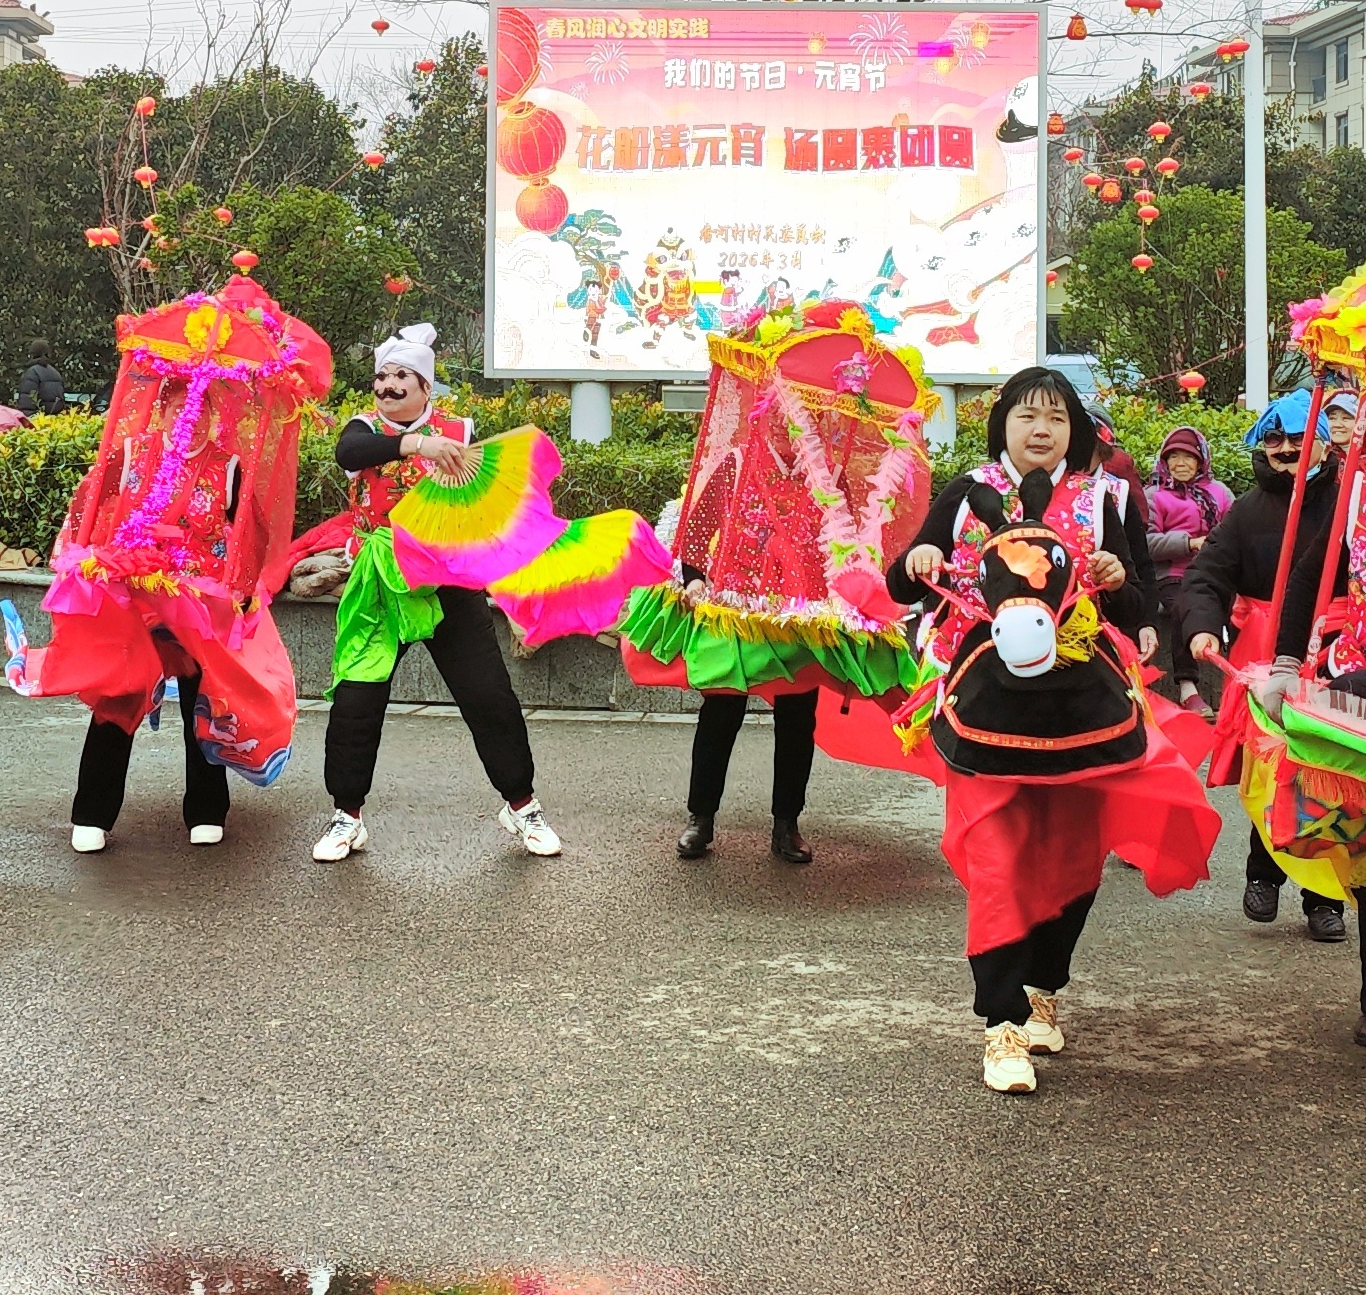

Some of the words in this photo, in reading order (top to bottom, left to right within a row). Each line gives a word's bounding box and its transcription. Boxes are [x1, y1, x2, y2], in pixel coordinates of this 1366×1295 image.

[546, 18, 710, 39] 春风润心文明实践
[663, 58, 887, 92] 我们的节日·元宵节
[575, 123, 766, 172] 花船漾元宵
